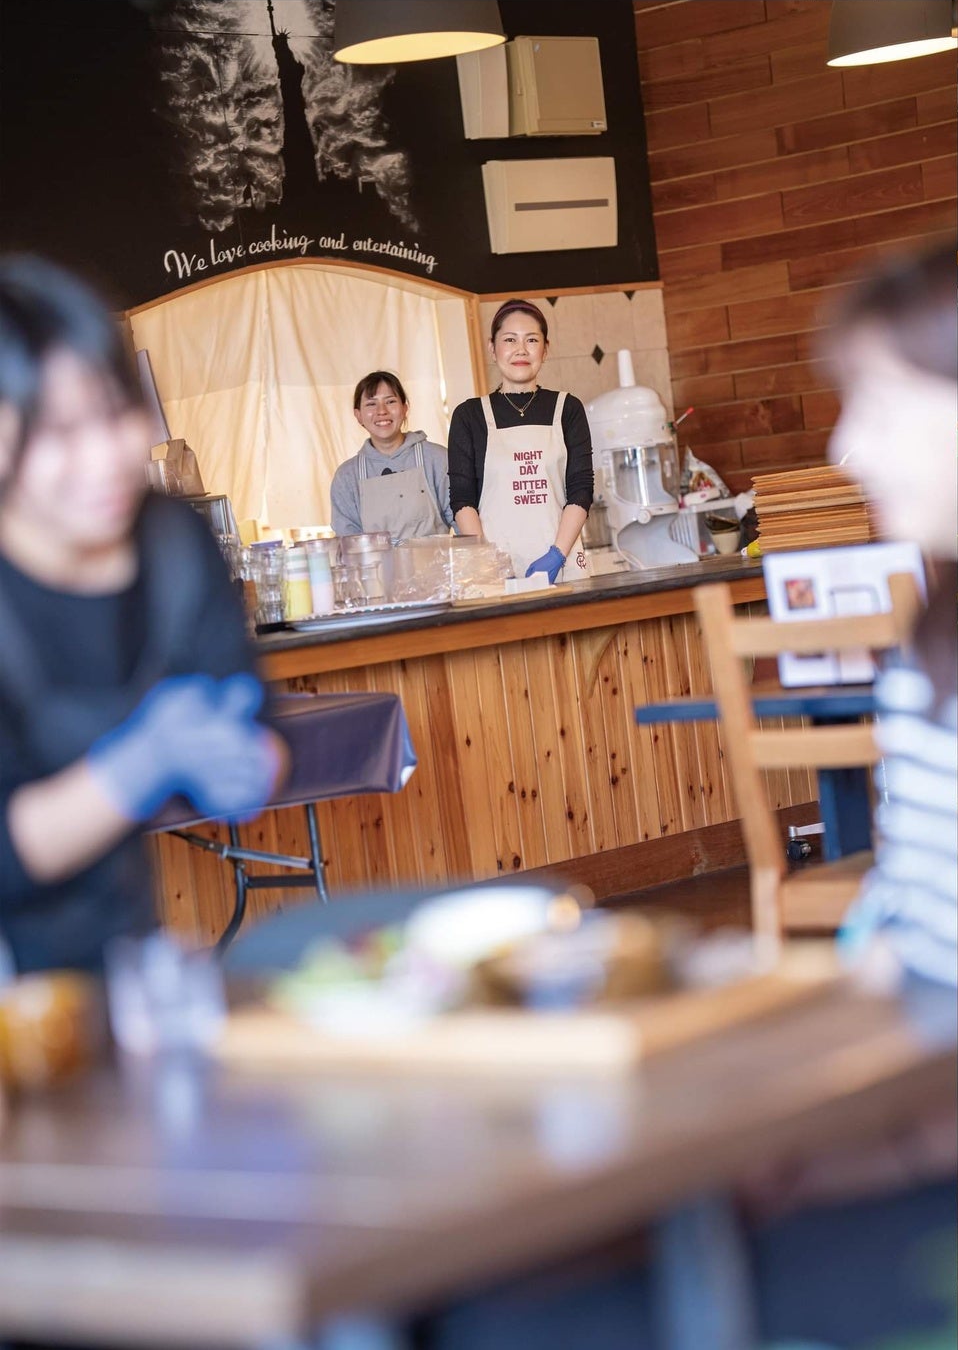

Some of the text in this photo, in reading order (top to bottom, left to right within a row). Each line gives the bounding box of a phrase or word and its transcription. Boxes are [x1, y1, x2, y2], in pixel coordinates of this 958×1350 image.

[163, 224, 439, 279] We love cooking and entertaining
[513, 450, 543, 461] NIGHT
[519, 465, 539, 475] DAY
[512, 479, 548, 491] BITTER
[513, 494, 548, 505] SWEET
